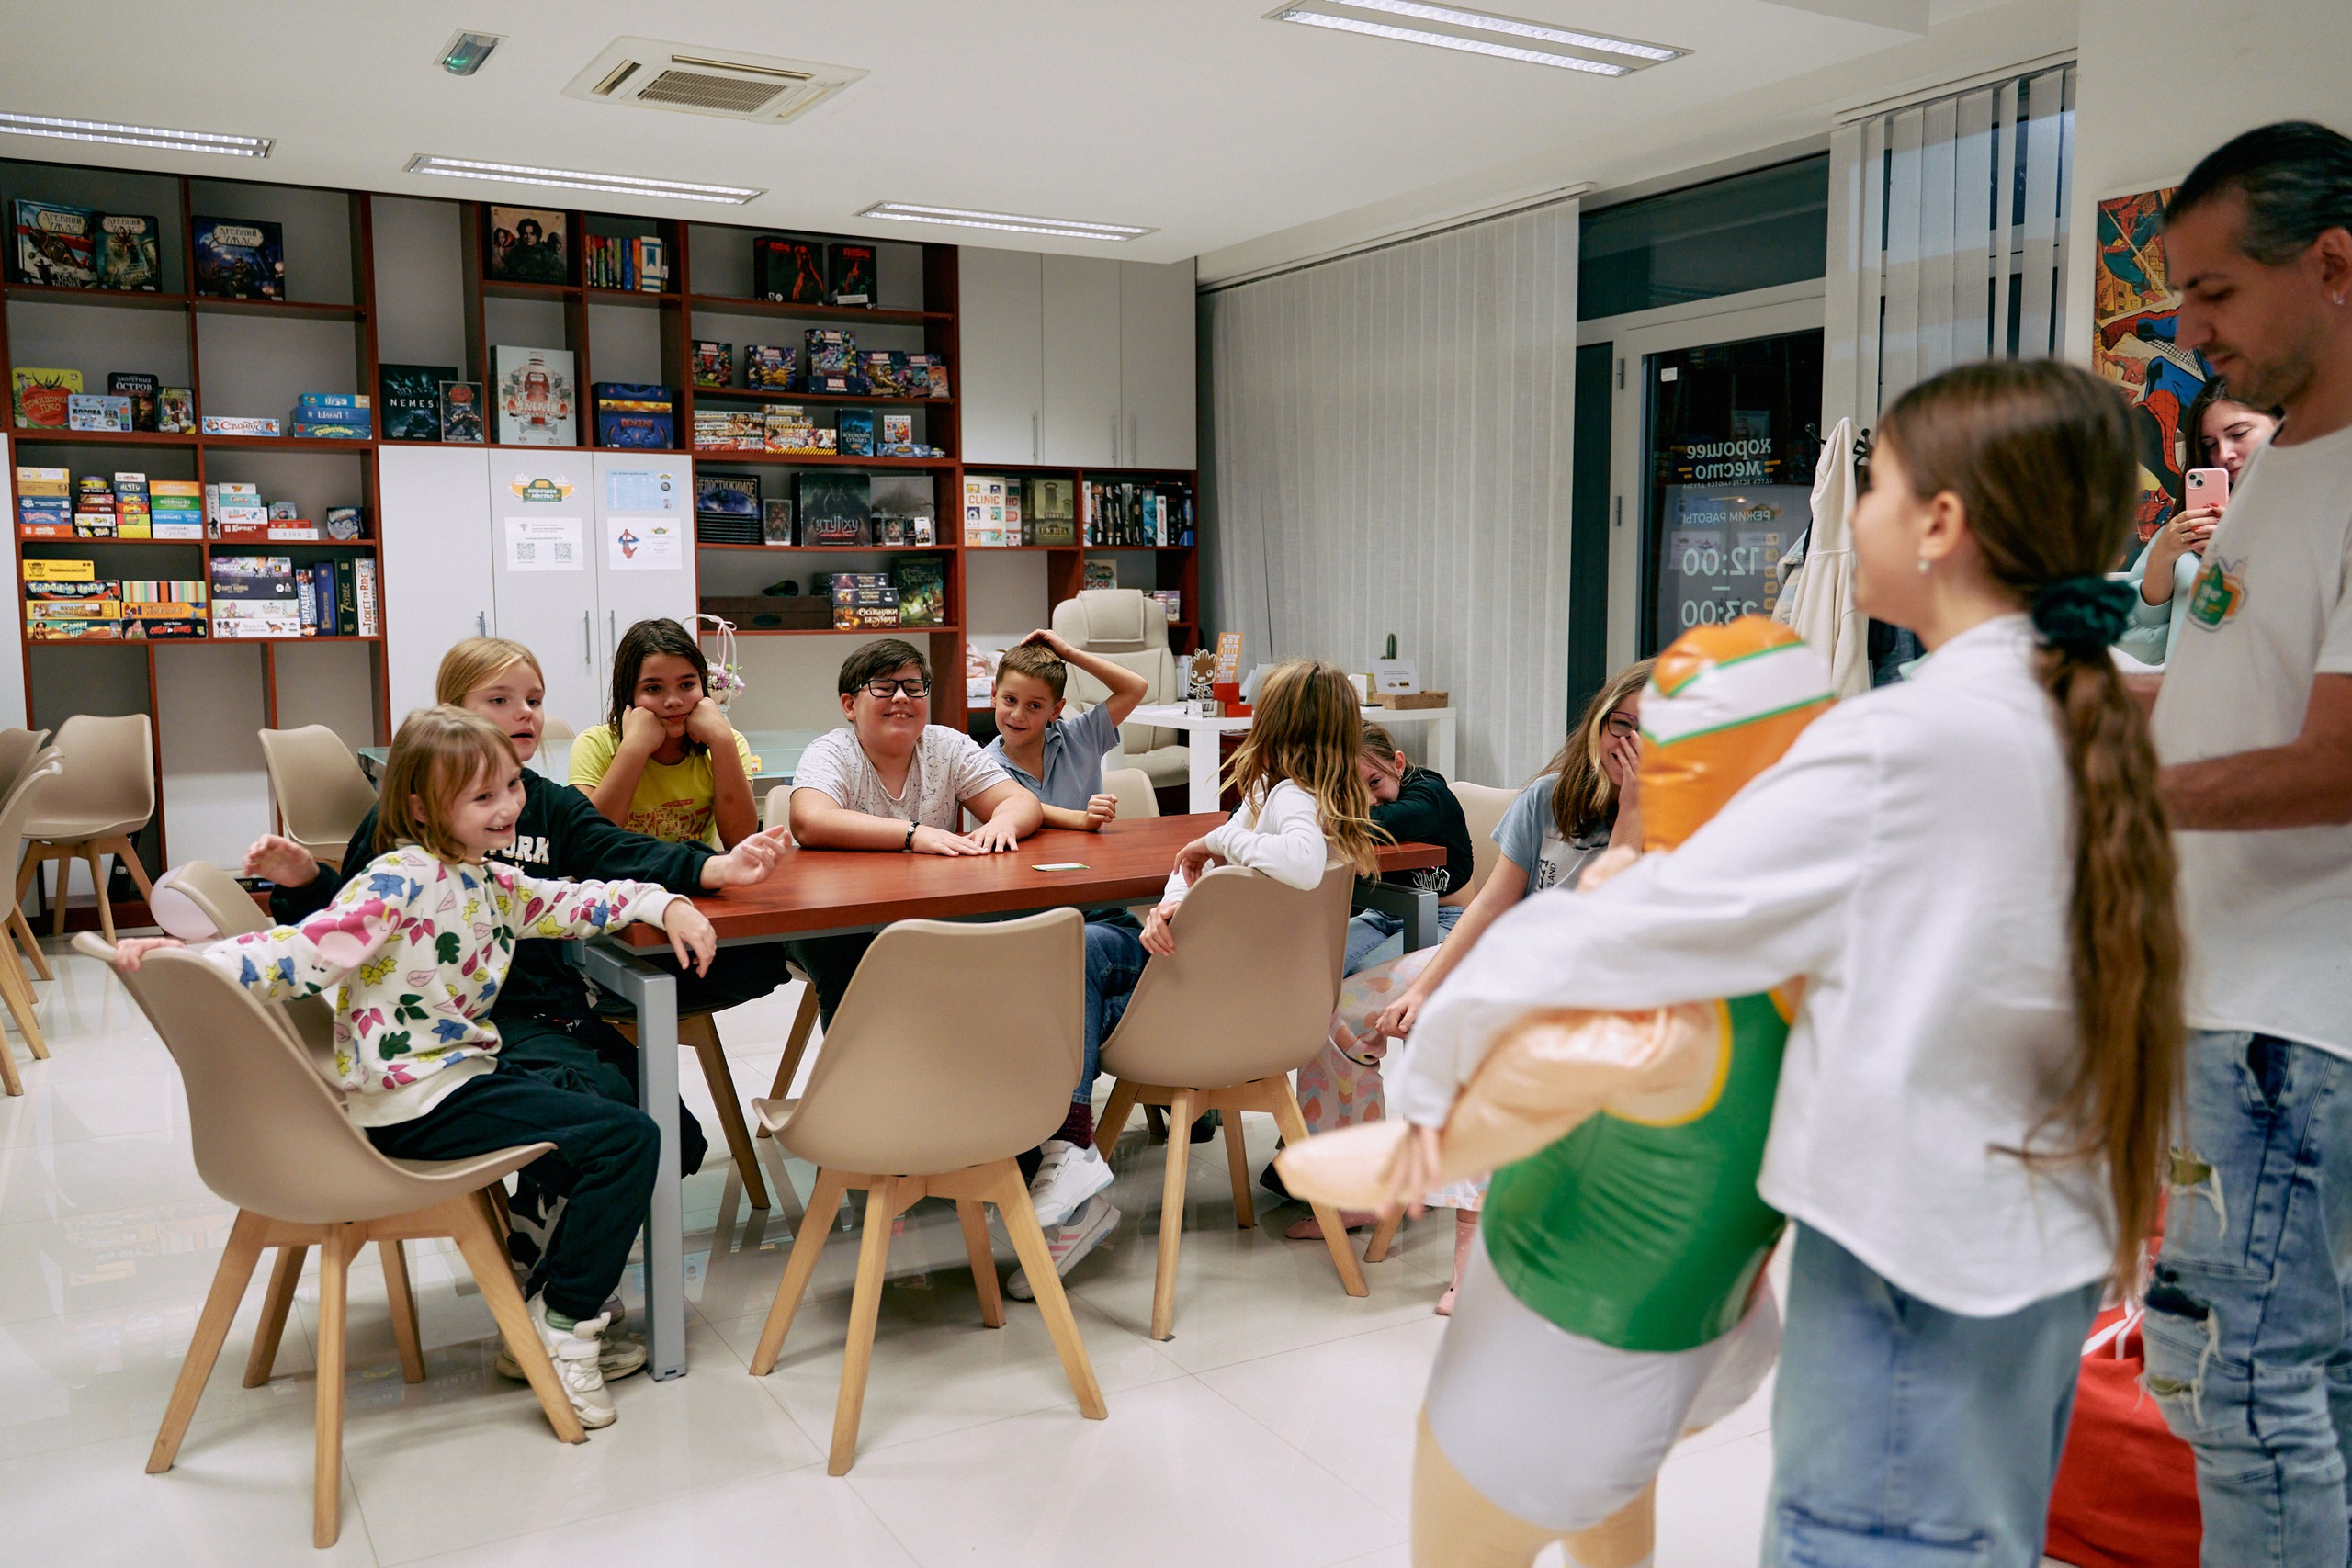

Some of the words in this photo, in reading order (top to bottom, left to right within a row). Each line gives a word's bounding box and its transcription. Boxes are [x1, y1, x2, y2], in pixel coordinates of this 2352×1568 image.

[44, 213, 82, 226] ДРЕВНИЙ
[50, 222, 79, 233] УЖАС
[219, 227, 257, 237] ДРЕВНИЙ
[223, 235, 254, 245] УЖАС
[700, 343, 718, 352] MARVEL
[116, 381, 153, 392] ОСТРОВ
[827, 378, 845, 388] MARVEL
[23, 396, 69, 411] ПОМИДОРН
[696, 479, 756, 497] НЕПОСТИЖИМОЕ
[968, 494, 1001, 505] CLINIC
[815, 515, 859, 534] КТУЛХУ
[359, 572, 369, 591] RIDE
[77, 581, 106, 595] UP!
[342, 582, 351, 606] ЧУДЕС
[300, 585, 311, 625] ЦИТАДЕЛИ
[339, 604, 356, 614] 7
[362, 600, 372, 627] TICKET
[857, 607, 899, 617] ОСОБНЯКИ
[864, 615, 897, 626] БЕЗУМИЯ
[1546, 863, 1556, 888] SLAND
